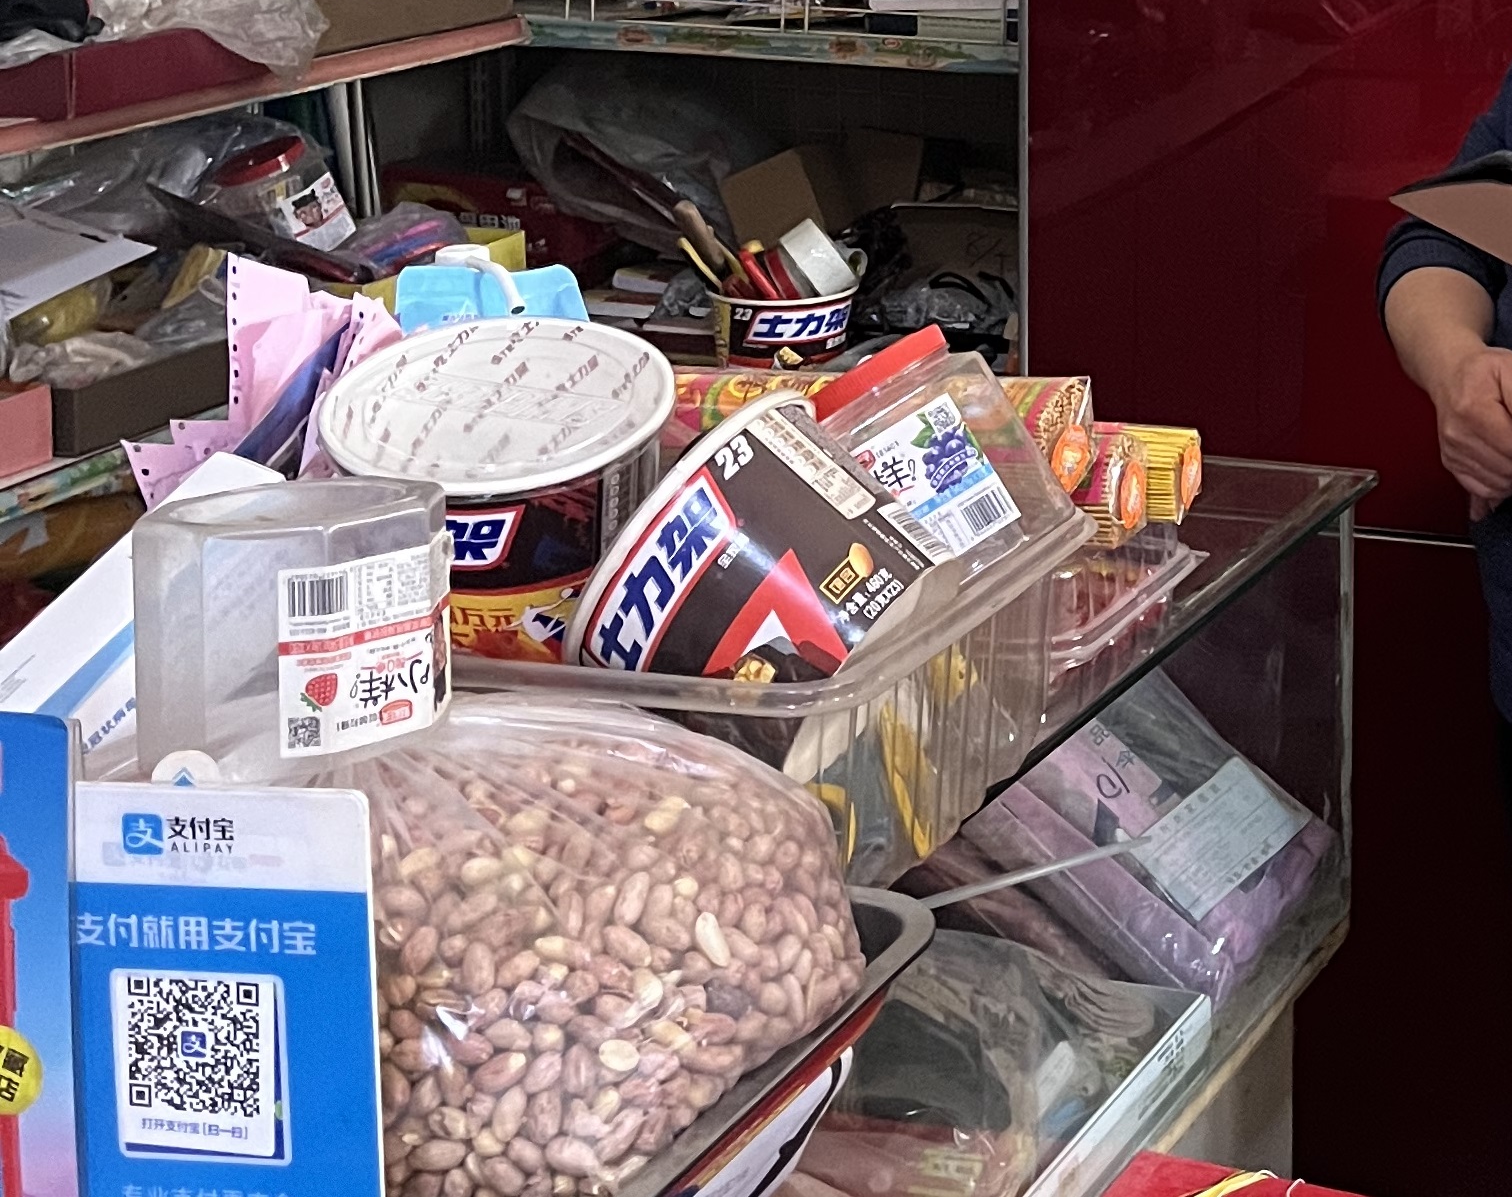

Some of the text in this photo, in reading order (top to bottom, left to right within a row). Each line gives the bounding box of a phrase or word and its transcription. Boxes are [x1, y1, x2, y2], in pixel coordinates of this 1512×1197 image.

[733, 307, 753, 321] 23
[752, 304, 851, 339] 士力架
[714, 432, 754, 481] 23
[599, 485, 724, 673] 士力架
[167, 816, 235, 841] 支付宝
[170, 841, 234, 854] ALIPAY
[76, 912, 317, 956] 支付就用支付宝
